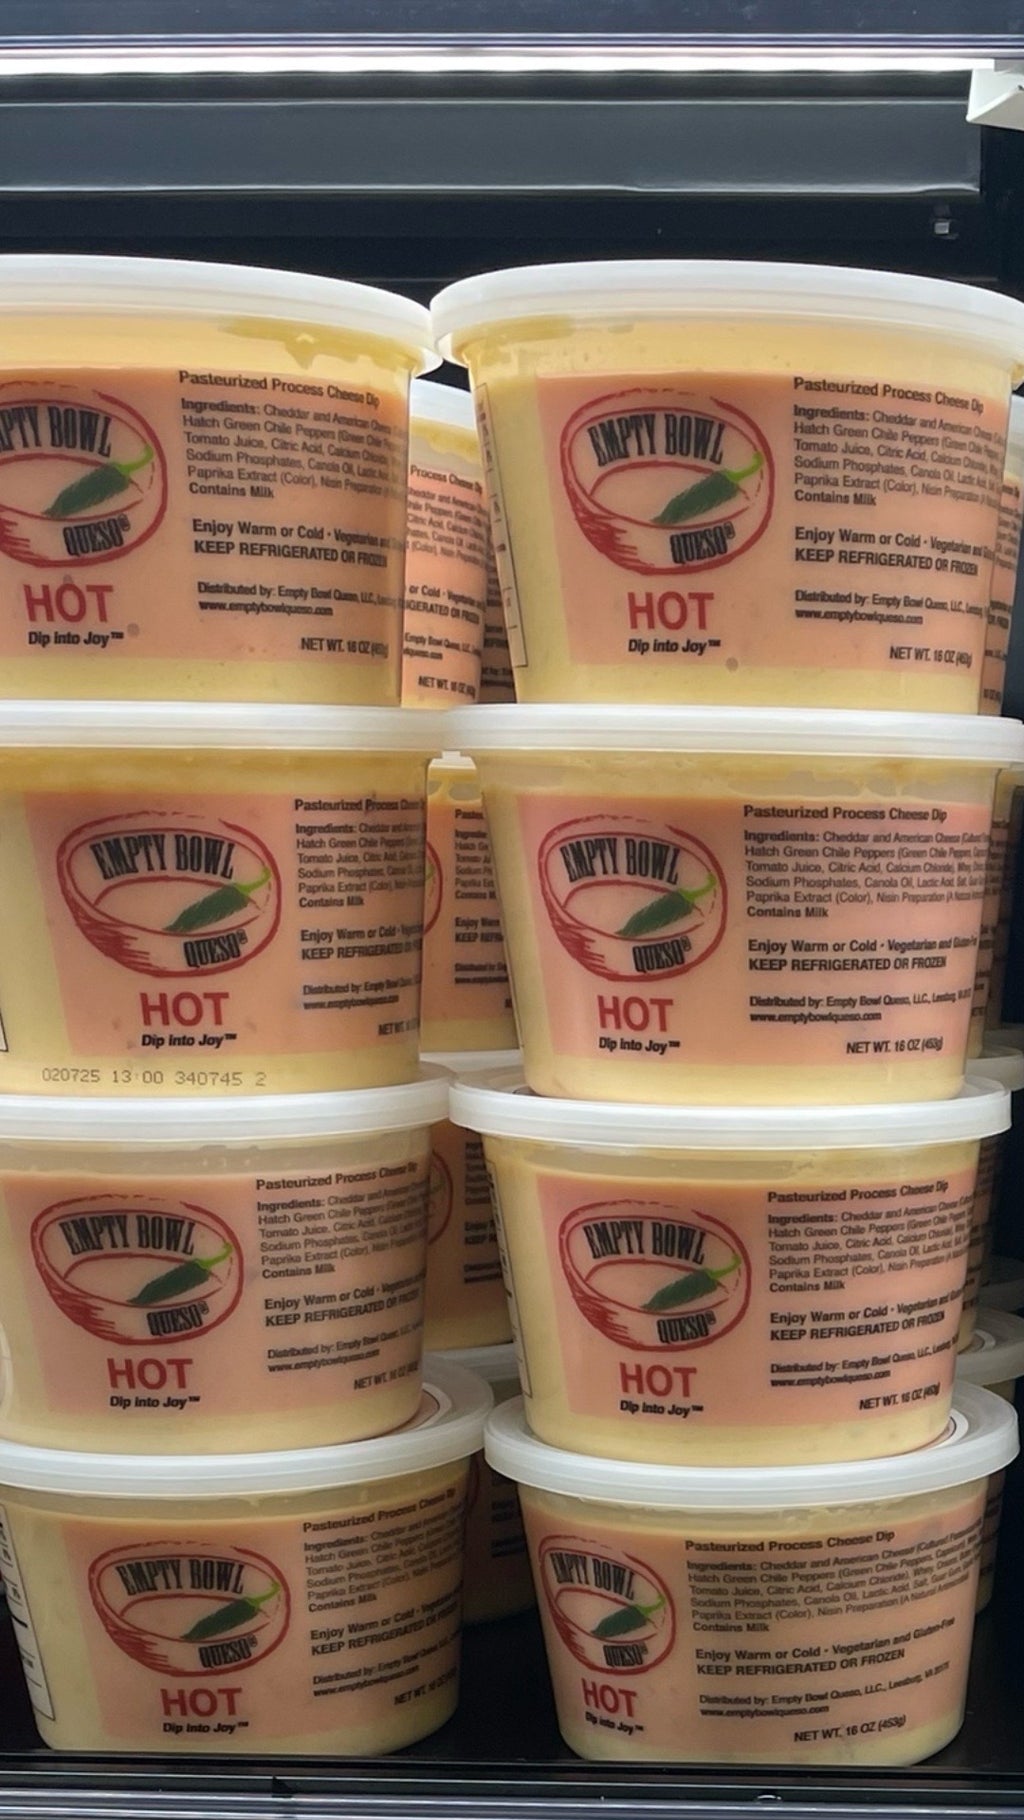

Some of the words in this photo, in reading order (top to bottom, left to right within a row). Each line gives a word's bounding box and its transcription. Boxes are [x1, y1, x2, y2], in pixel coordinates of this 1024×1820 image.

[587, 414, 657, 467] EMPTY
[665, 413, 726, 465] BOWL
[24, 584, 113, 623] HOT
[628, 591, 714, 630] HOT
[628, 638, 649, 655] Dip
[652, 638, 678, 653] into
[744, 804, 830, 820] Pasteurized
[833, 807, 886, 821] Process
[889, 806, 930, 822] Cheese
[932, 808, 948, 823] Dip
[89, 834, 166, 881] EMPTY
[175, 835, 236, 881] BOWL
[747, 904, 801, 919] Contains
[805, 904, 830, 918] Milk
[748, 938, 787, 956] Enjoy
[790, 938, 829, 953] Warm
[833, 941, 846, 953] or
[849, 937, 878, 953] Cold
[748, 957, 787, 972] KEEP
[790, 957, 891, 972] REFRIGERATED
[894, 956, 908, 971] OR
[912, 955, 948, 971] FROZEN
[140, 992, 229, 1027] HOT
[597, 994, 673, 1032] HOT
[41, 1067, 101, 1084] 020725
[174, 1070, 243, 1087] 340745
[255, 1072, 267, 1087] 2
[58, 1214, 132, 1256] EMPTY
[138, 1217, 195, 1256] BOWL
[107, 1357, 193, 1391] HOT
[619, 1361, 697, 1398] HOT
[160, 1687, 242, 1717] HOT
[580, 1677, 638, 1719] HOT
